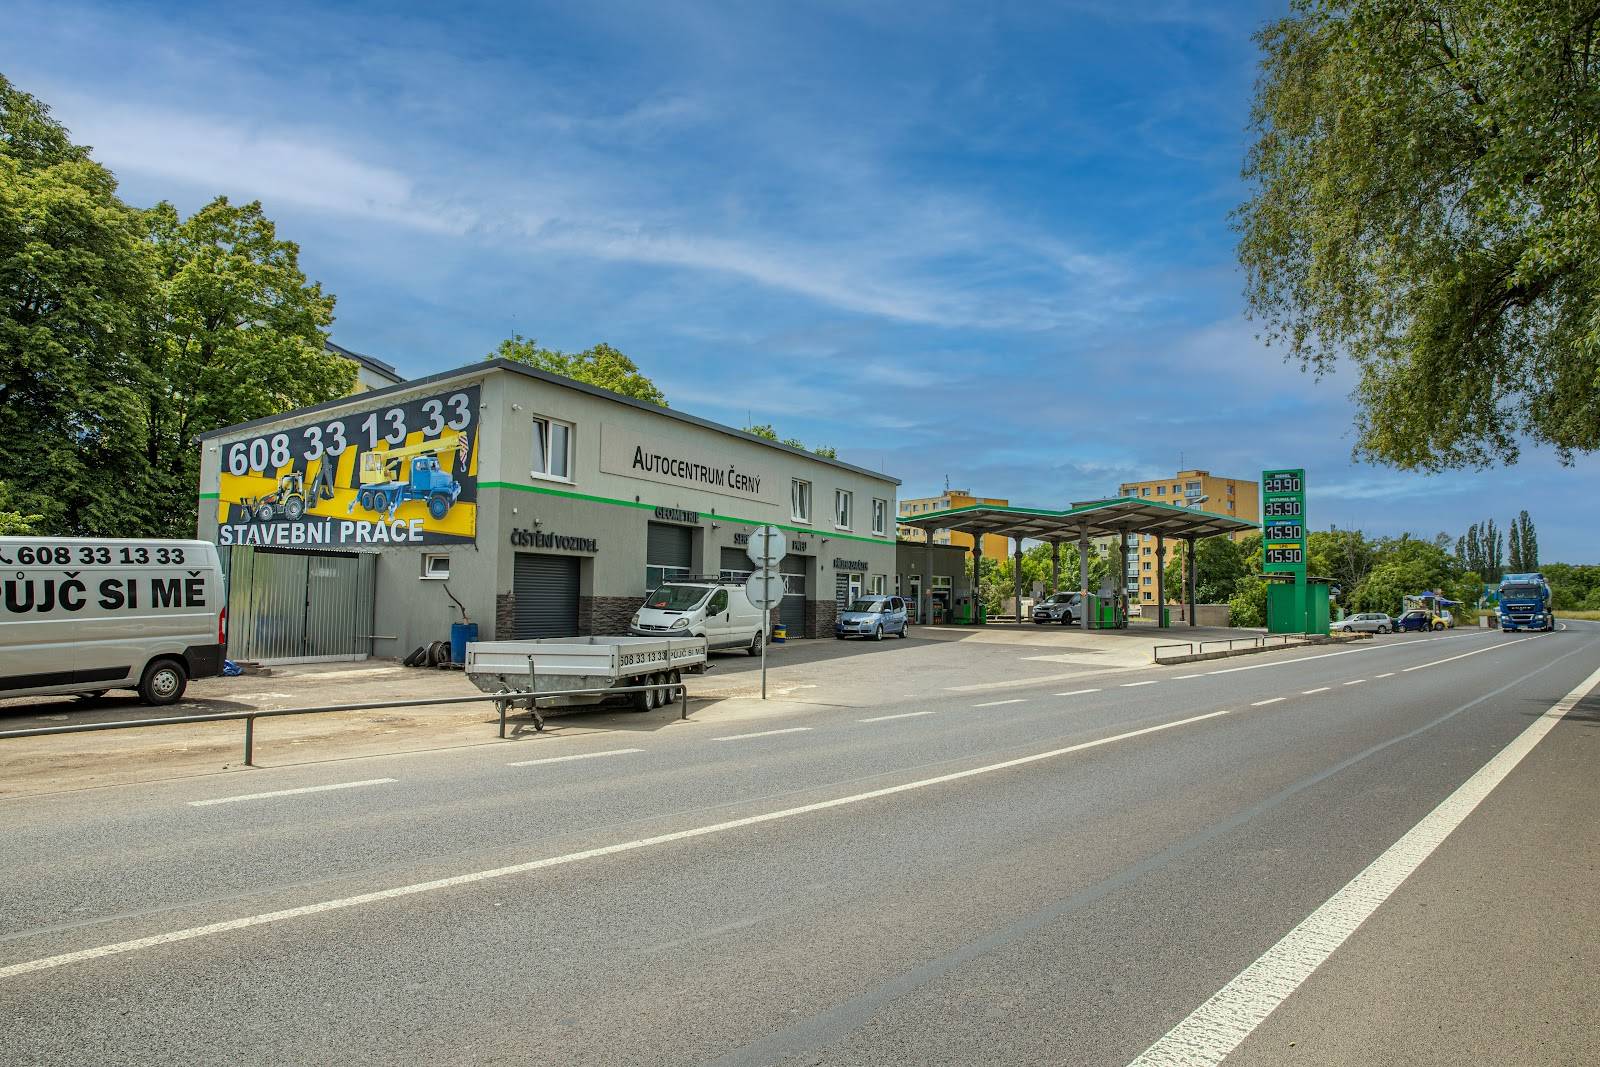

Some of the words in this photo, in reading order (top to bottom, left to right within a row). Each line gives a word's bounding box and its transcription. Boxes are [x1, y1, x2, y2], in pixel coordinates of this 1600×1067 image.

[228, 433, 291, 476] 608
[303, 421, 347, 461] 33
[361, 408, 407, 449] 13
[421, 393, 472, 437] 33
[632, 445, 724, 487] AUTOCENTRUM
[727, 464, 761, 494] ČERNÝ
[1265, 478, 1301, 493] 29.90
[1265, 502, 1301, 516] 35.90
[220, 517, 331, 545] STAVEBNÍ
[340, 512, 424, 543] PRÁCE
[1267, 525, 1302, 539] 15.90
[511, 527, 555, 548] ČIŠTĚNÍ
[554, 534, 599, 553] VOZIDEL
[17, 546, 72, 565] 608
[79, 547, 112, 565] 33
[120, 547, 150, 565] 13
[156, 548, 185, 565] 33
[1267, 549, 1302, 563] 15.90
[0, 571, 87, 614] ŮJČ
[97, 578, 138, 610] SI
[151, 570, 206, 609] MĚ
[636, 653, 645, 664] 33
[648, 651, 656, 662] 13
[657, 651, 666, 661] 33
